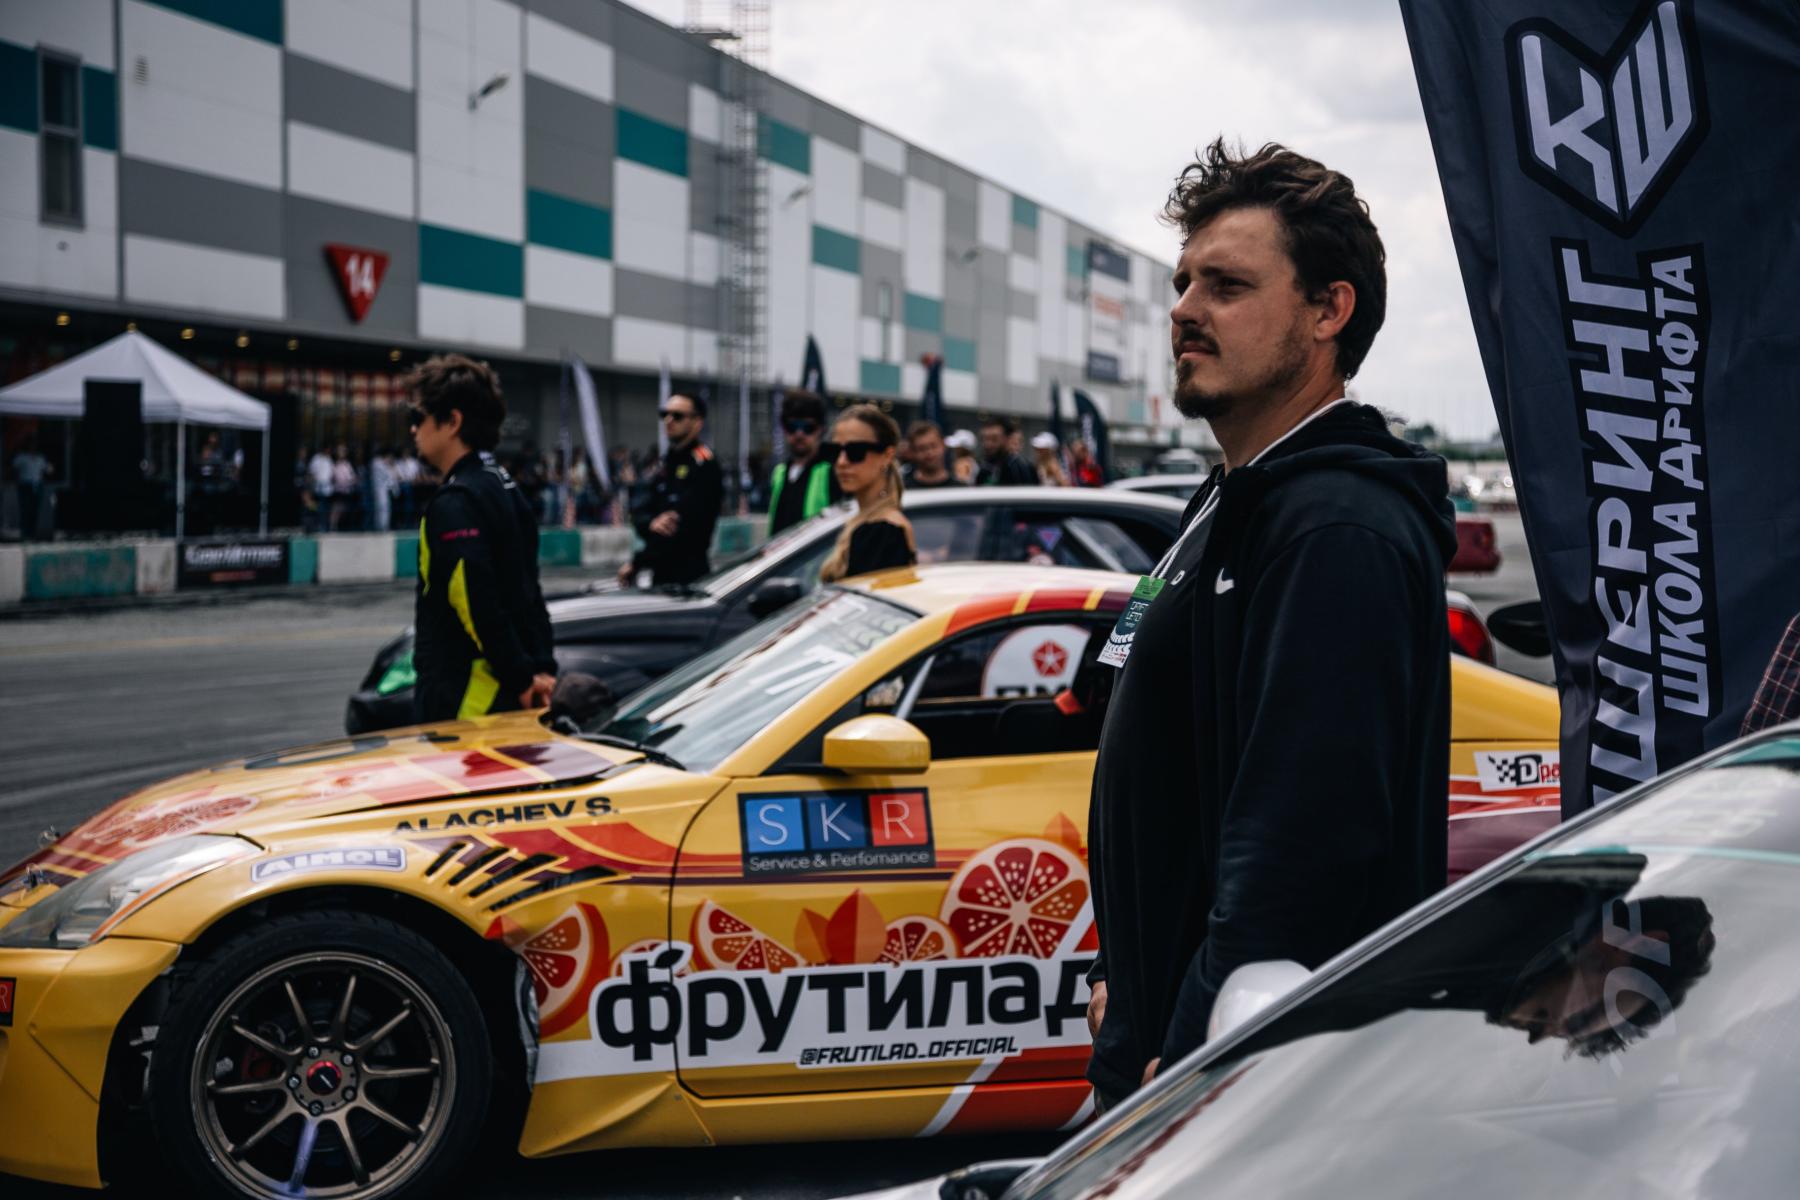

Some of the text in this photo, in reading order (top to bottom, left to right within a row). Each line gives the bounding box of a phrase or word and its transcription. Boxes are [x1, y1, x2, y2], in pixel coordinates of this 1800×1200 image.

[346, 254, 375, 299] 14
[1650, 255, 1709, 717] ШКОЛА ДРИФТА
[395, 796, 620, 833] ALACHEV S.
[758, 800, 915, 846] SKR
[259, 850, 398, 877] AIMOL
[750, 854, 811, 872] Service
[813, 854, 827, 868] &
[800, 1037, 1018, 1066] @FRUTILAD_OFFICIAL
